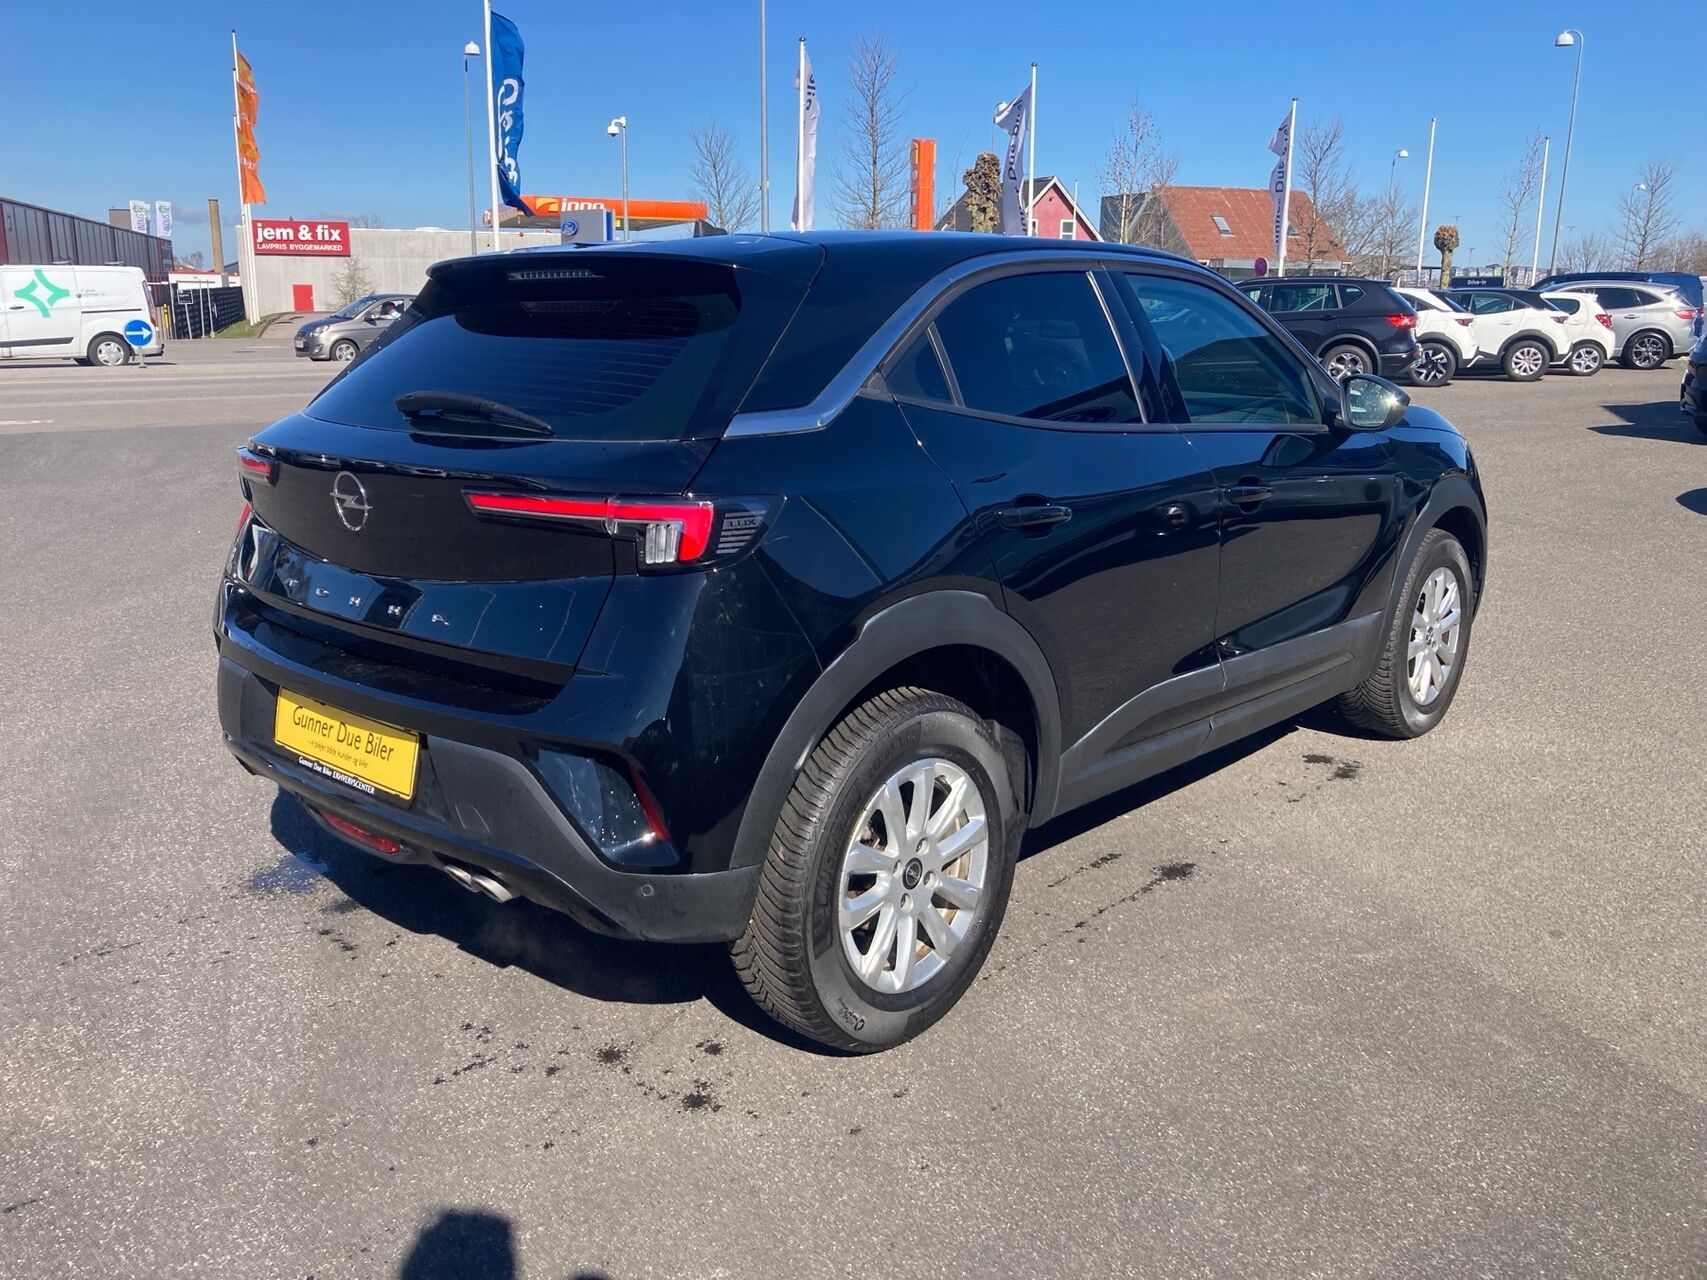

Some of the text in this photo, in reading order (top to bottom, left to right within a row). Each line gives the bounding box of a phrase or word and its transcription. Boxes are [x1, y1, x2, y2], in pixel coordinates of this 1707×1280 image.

[1008, 144, 1017, 181] Due
[256, 222, 342, 242] jem & fix
[293, 706, 395, 761] Gunner Due Biler
[313, 762, 323, 773] Due
